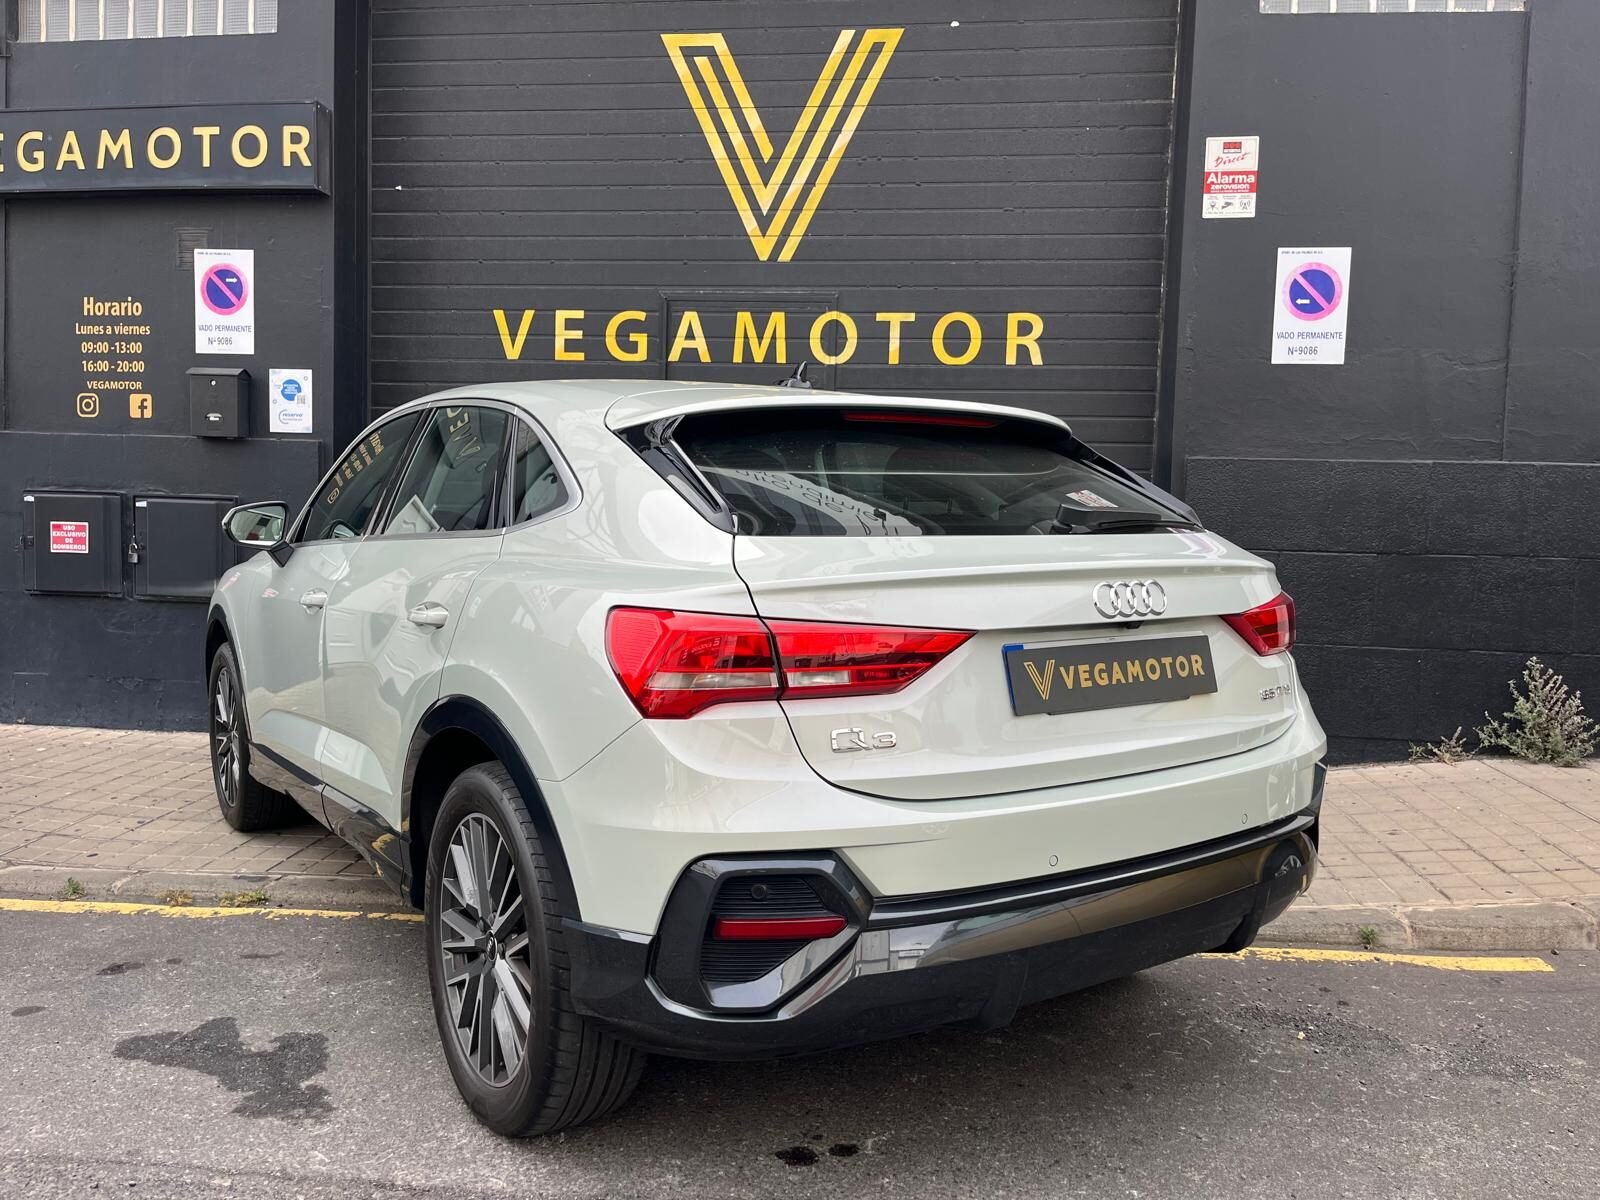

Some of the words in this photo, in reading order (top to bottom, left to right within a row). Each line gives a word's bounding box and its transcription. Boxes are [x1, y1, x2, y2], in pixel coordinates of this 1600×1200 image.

[0, 124, 312, 173] GAMOTOR
[1206, 172, 1255, 184] Alarma
[83, 296, 142, 316] Horario
[75, 322, 104, 335] Lunes
[105, 325, 112, 335] a
[114, 323, 151, 335] viernes
[198, 324, 213, 332] VADO
[215, 325, 252, 333] PERMANENTE
[492, 309, 1045, 366] VEGAMOTOR
[1276, 331, 1295, 340] VADO
[1297, 331, 1343, 340] PERMANENTE
[81, 341, 109, 353] 09:00
[82, 360, 109, 372] 16:00
[116, 361, 145, 372] 20:00
[87, 381, 142, 390] VEGAMOTOR
[1058, 654, 1206, 690] VEGAMOTOR
[830, 727, 897, 753] Q3
